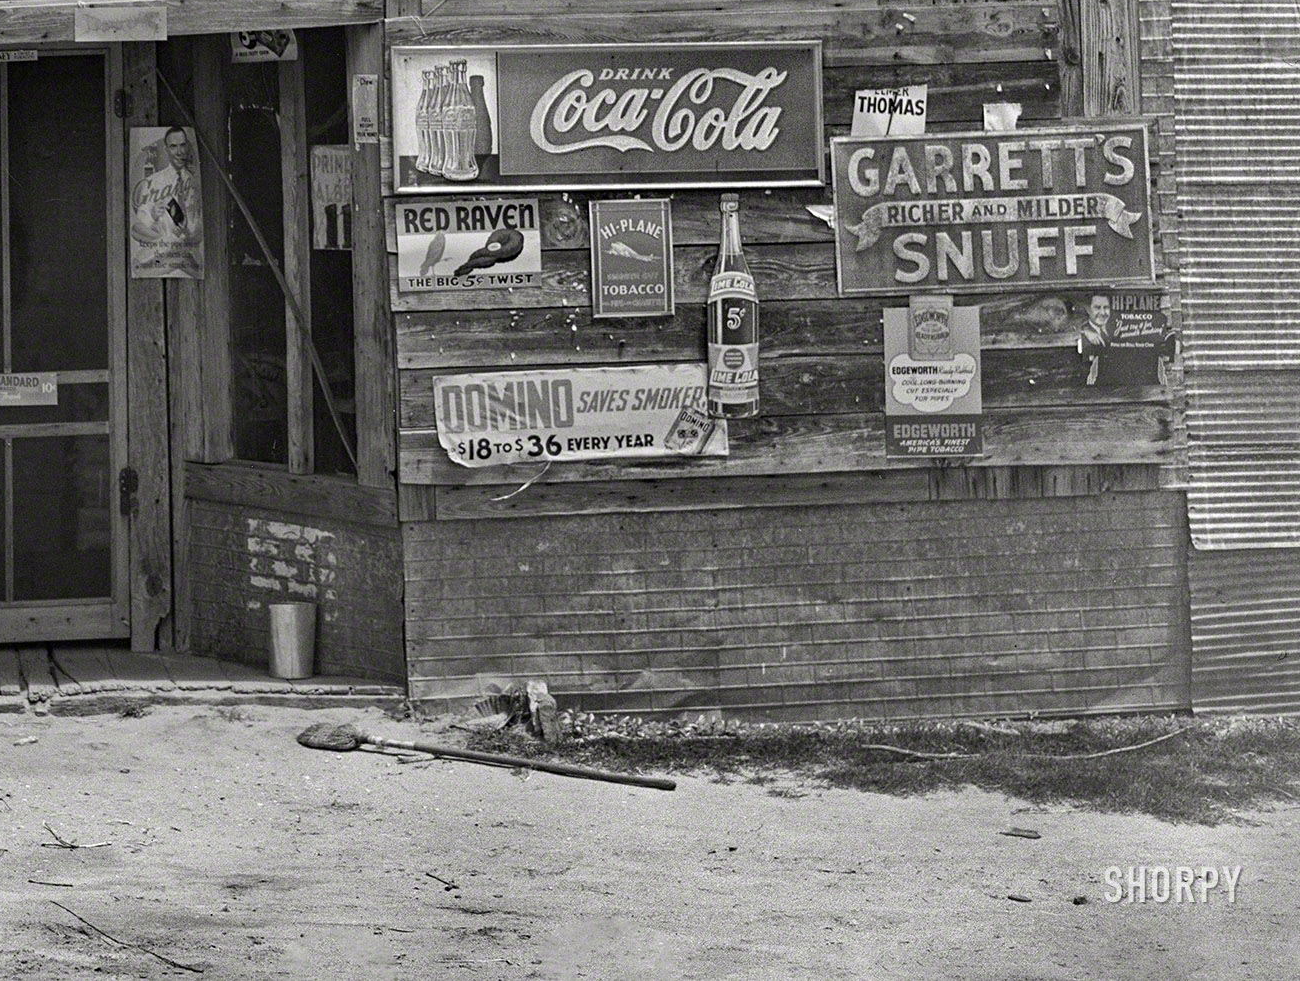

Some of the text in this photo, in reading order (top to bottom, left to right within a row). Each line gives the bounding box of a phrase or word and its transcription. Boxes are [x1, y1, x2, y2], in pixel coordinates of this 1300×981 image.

[599, 68, 673, 80] DRINK
[530, 67, 787, 154] Coca-Cola
[858, 96, 925, 117] THOMAS
[848, 134, 1136, 198] GARRETT'S
[403, 206, 450, 233] RED
[887, 197, 1099, 223] RICHER AND MILDER
[600, 218, 663, 240] HI-PLANE
[892, 225, 1097, 283] SNUFF
[408, 273, 534, 288] THE BIG 5¢ TWIST
[602, 284, 664, 295] TOBACCO
[733, 277, 754, 291] COLA
[726, 307, 746, 330] 5¢
[733, 368, 759, 385] COLA
[892, 365, 938, 375] EDGEWORTH
[441, 379, 708, 434] DOMINO SAVES SMOKER
[680, 411, 710, 433] DOMINO
[893, 423, 976, 438] EDGEWORTH
[458, 437, 492, 460] $18
[495, 443, 513, 455] TO
[567, 436, 614, 452] EVERY
[616, 433, 655, 449] YEAR
[900, 438, 971, 446] AMERICA'S FINEST
[930, 445, 965, 453] TOBACCO
